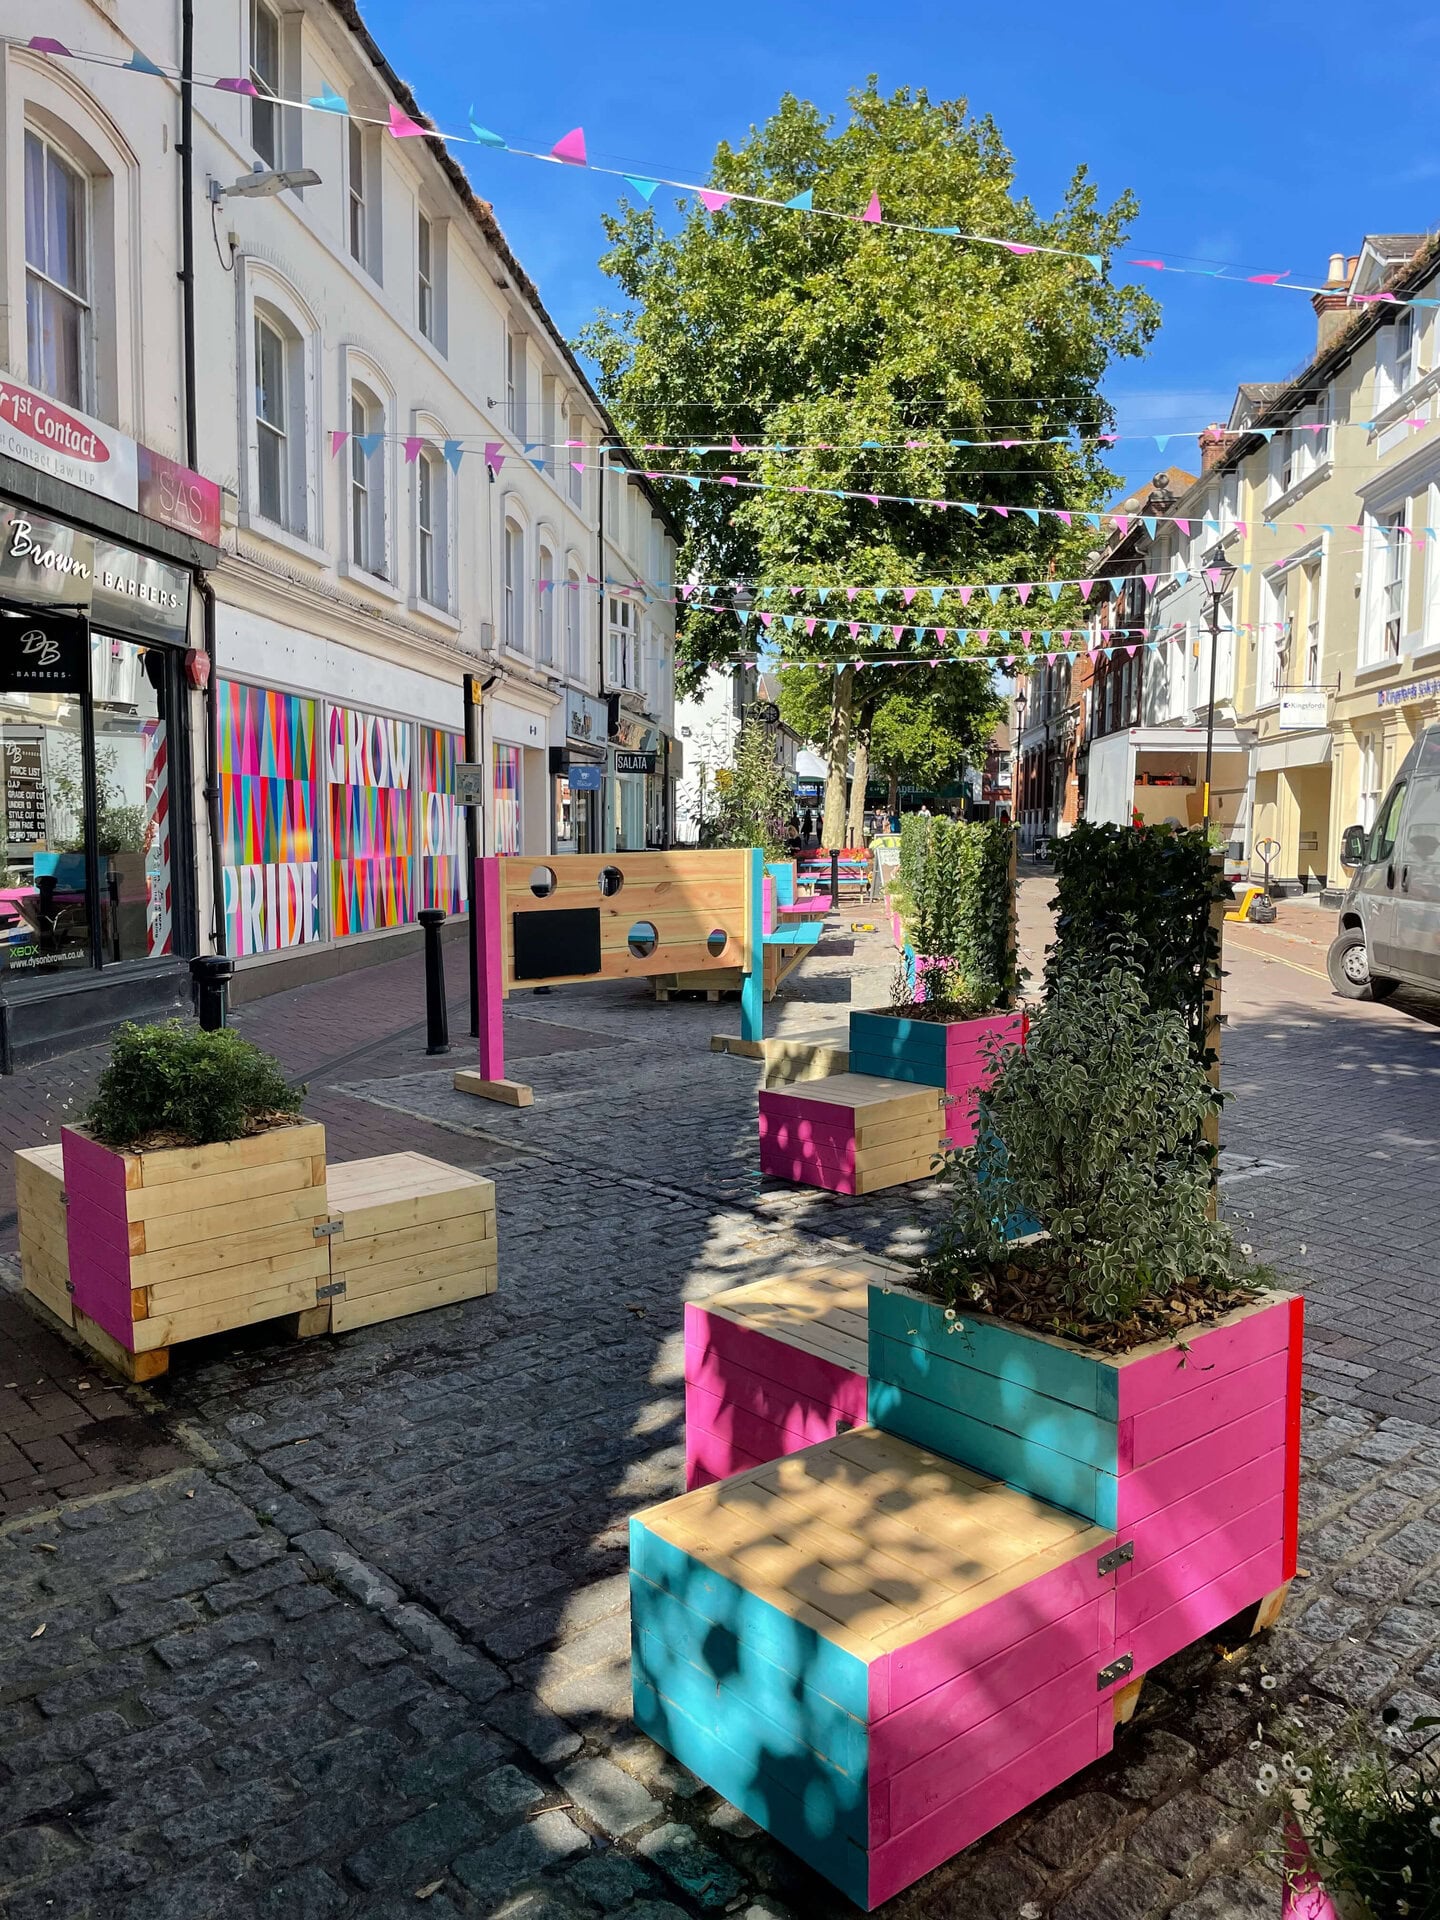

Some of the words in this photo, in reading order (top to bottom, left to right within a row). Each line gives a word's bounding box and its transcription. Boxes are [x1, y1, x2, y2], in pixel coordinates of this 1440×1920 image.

[12, 394, 32, 422] 1st
[34, 407, 97, 459] Contact
[8, 437, 50, 467] Contact
[54, 458, 75, 479] Law
[78, 468, 95, 486] LLP
[160, 471, 203, 524] SAS
[9, 519, 91, 580] Brown
[1290, 702, 1326, 710] Kingsfords
[327, 704, 412, 790] GROW
[617, 756, 647, 769] SALATA
[10, 765, 27, 776] PRICE
[28, 767, 41, 777] LIST
[8, 790, 25, 799] GRADE
[26, 791, 35, 800] CUT
[8, 800, 25, 809] UNDER
[9, 811, 24, 819] STYLE
[25, 811, 35, 819] CUT
[22, 821, 34, 830] FADE
[9, 831, 25, 839] BEARD
[27, 831, 38, 839] TRIM
[222, 861, 320, 958] PRIDE
[9, 944, 39, 959] XBOX
[9, 948, 85, 970] www.dysonbrown.co.uk
